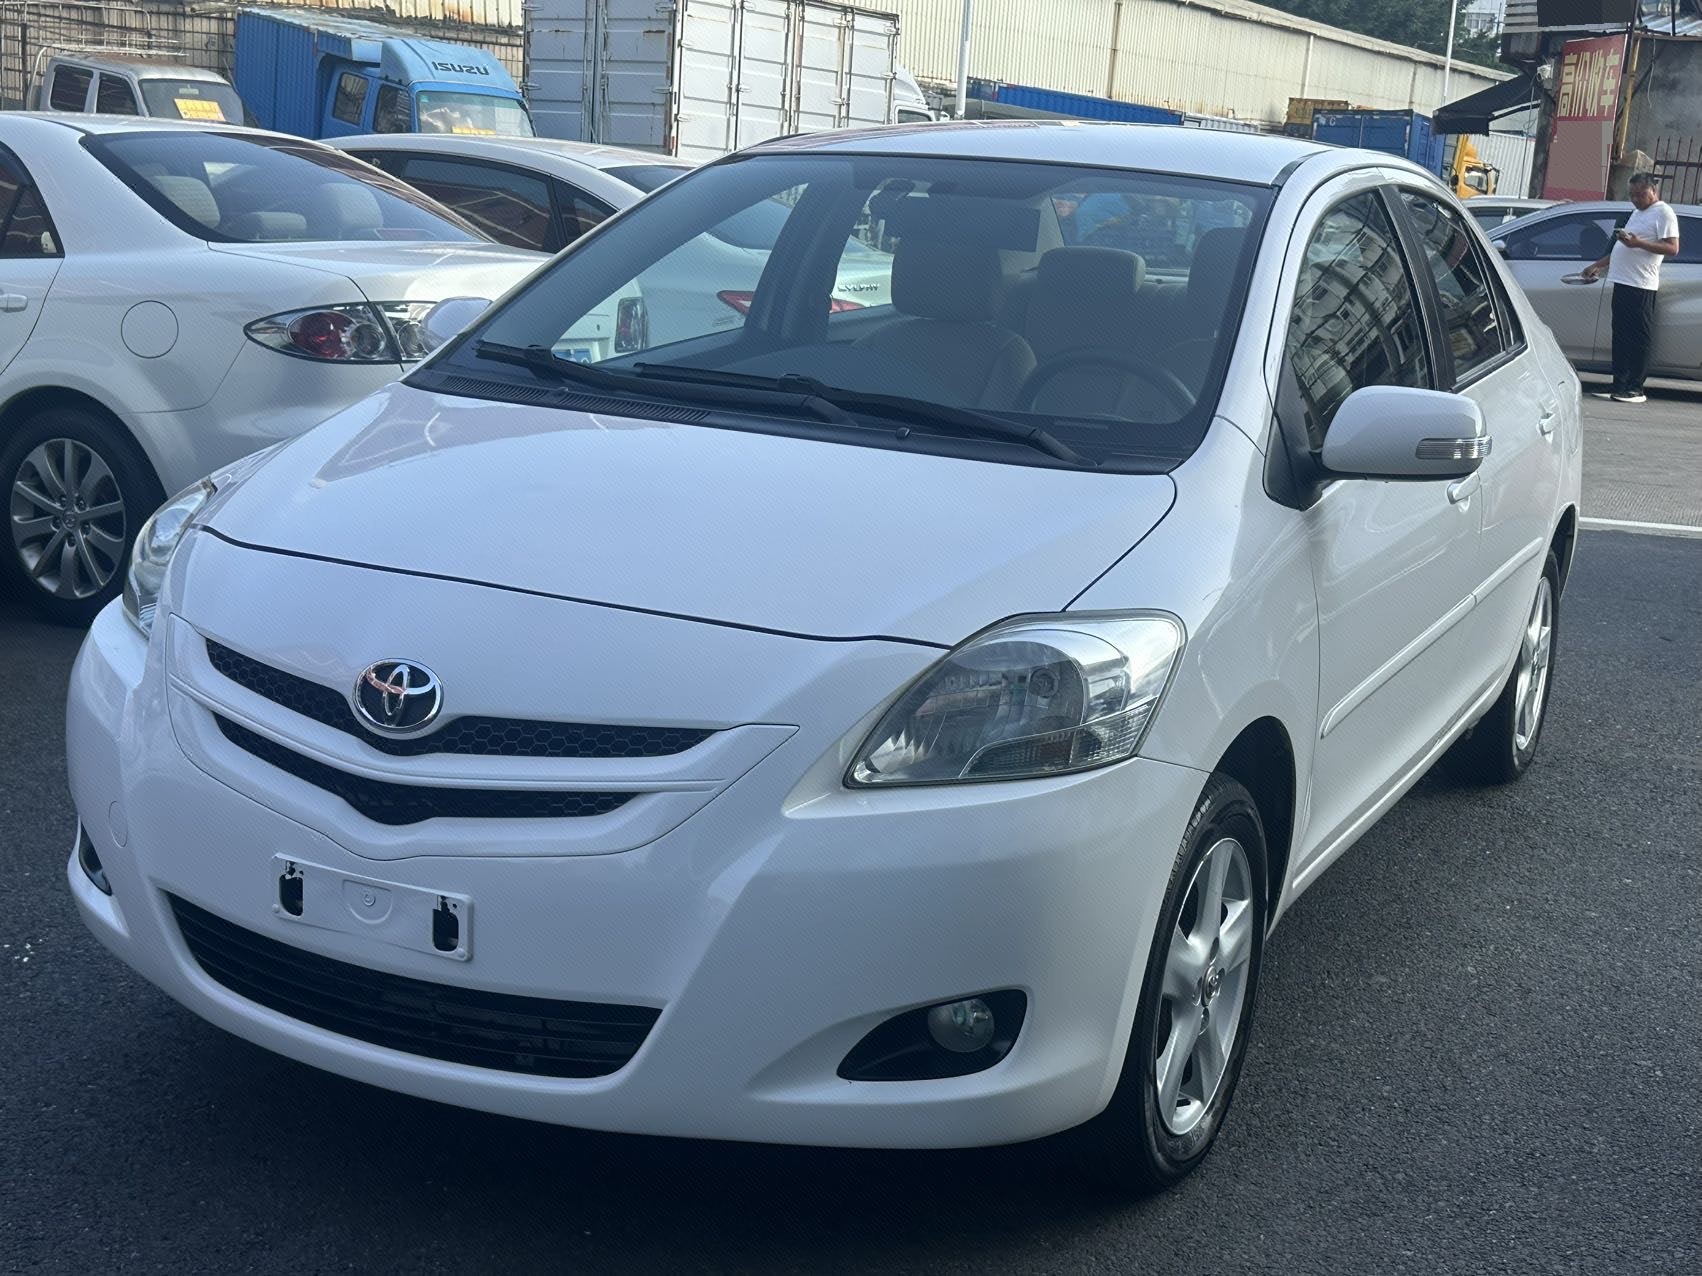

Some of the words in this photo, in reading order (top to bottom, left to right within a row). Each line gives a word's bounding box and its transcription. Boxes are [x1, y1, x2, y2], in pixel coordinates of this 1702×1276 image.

[431, 61, 490, 76] ISUZU
[1556, 48, 1620, 117] 高价收车
